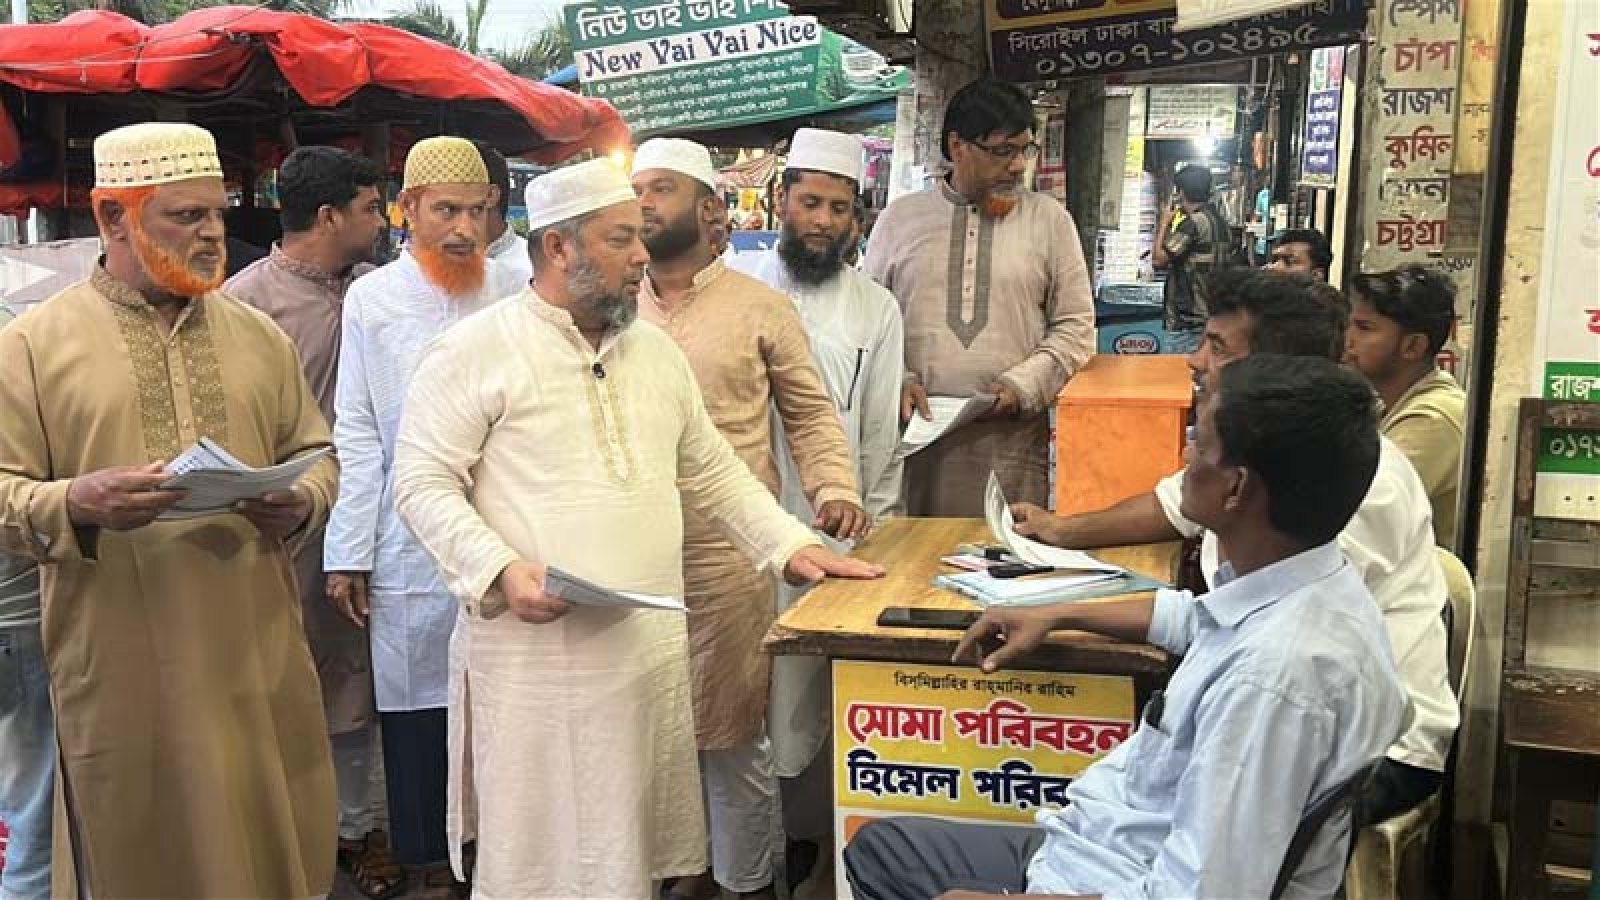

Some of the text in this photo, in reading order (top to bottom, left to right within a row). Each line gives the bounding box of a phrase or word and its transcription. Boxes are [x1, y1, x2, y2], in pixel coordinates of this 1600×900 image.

[577, 6, 629, 41] নিউ
[632, 0, 683, 31] ভাই
[584, 50, 642, 77] New
[649, 38, 696, 64] Vai
[702, 29, 750, 57] Vai
[756, 22, 817, 49] Nice
[849, 700, 1132, 754] সোমা পরিবহন
[848, 749, 960, 800] হিমেল
